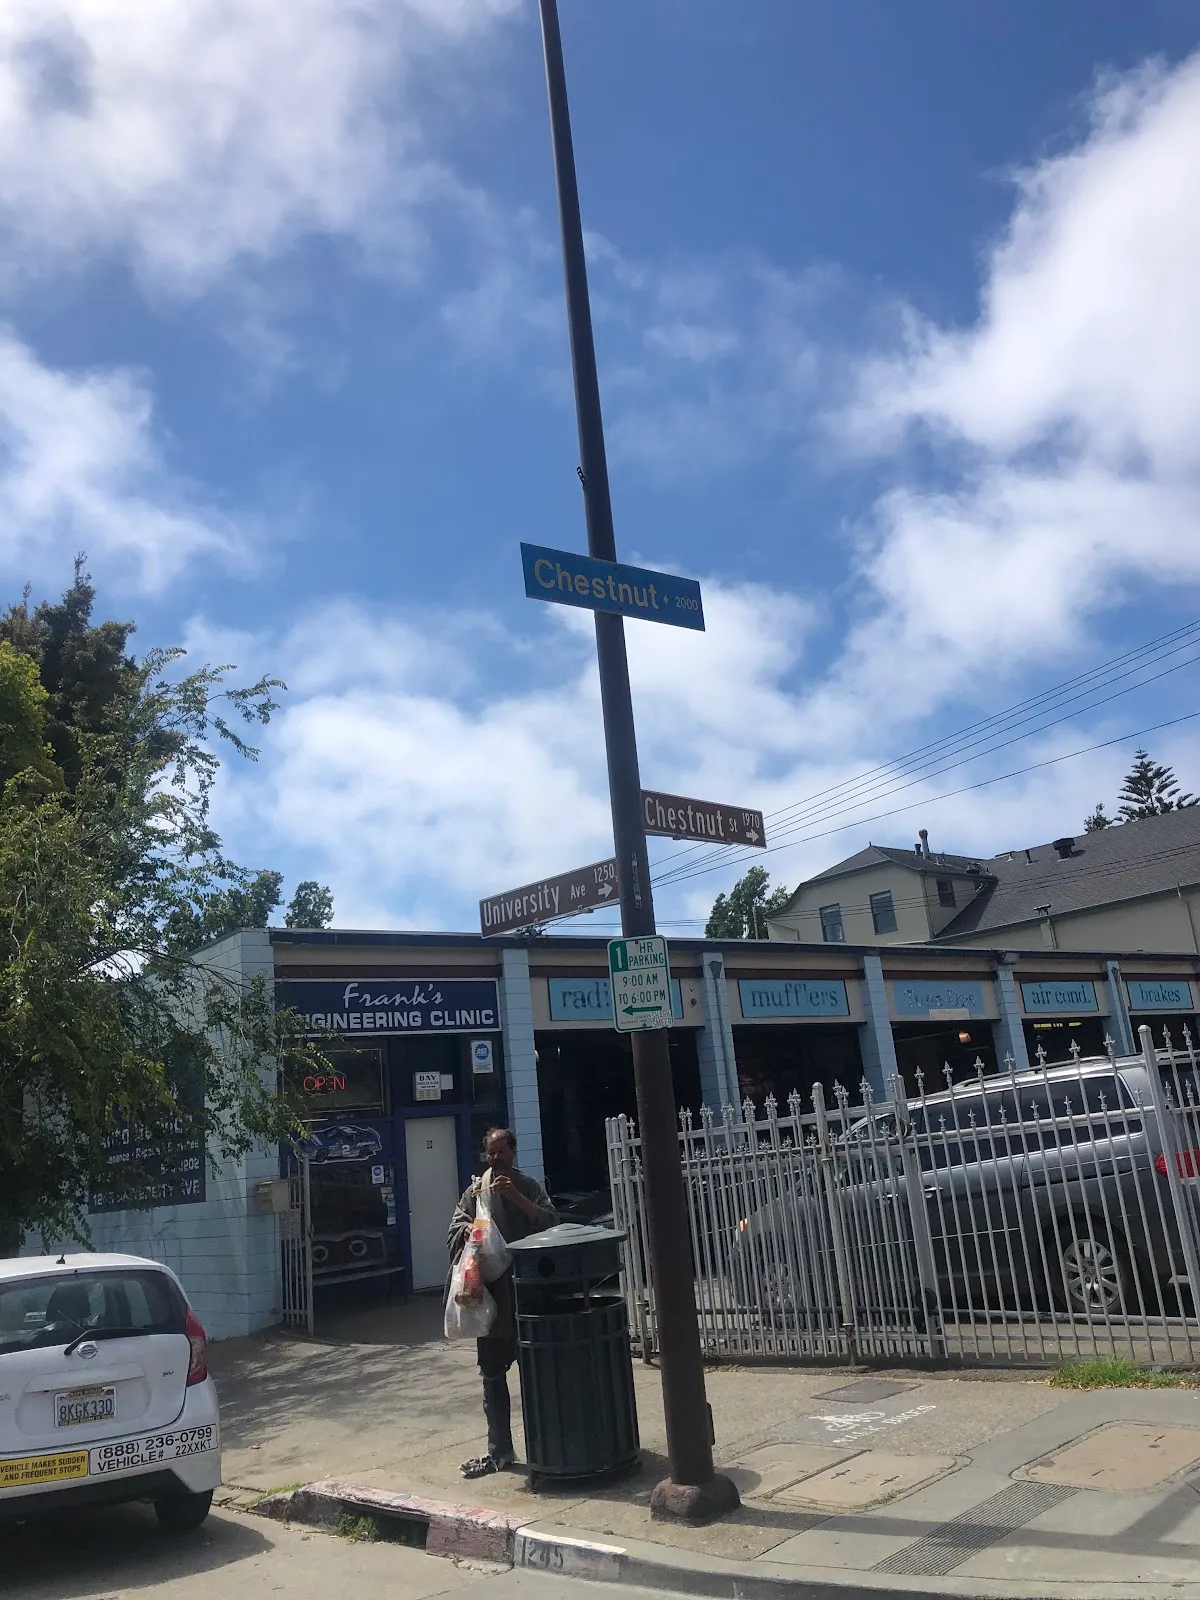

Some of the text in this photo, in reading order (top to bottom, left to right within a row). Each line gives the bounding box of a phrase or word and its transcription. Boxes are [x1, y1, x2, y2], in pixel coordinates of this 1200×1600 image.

[534, 559, 698, 611] Chestnut 2000
[644, 797, 760, 837] Chestnut St 1970
[483, 863, 615, 927] University Ave 1250
[615, 942, 653, 969] 1 HR
[629, 953, 664, 967] PARKING
[622, 973, 659, 987] 9:00 AM
[342, 982, 443, 1008] Frank's
[618, 989, 666, 1005] TO 6:00 PM
[750, 983, 838, 1008] mufflers
[1032, 984, 1051, 1004] air
[1140, 983, 1181, 1003] brakes
[295, 1009, 494, 1029] NGINEERING CLINIC
[303, 1075, 345, 1092] OPEN
[59, 1399, 113, 1421] 8KGK330
[98, 1426, 212, 1461] (888) 236-0799
[175, 1438, 212, 1456] 22XXKT
[0, 1455, 86, 1473] VEHICLE MAKES SUDDEN
[3, 1464, 81, 1482] AND FREQUENT STOPS
